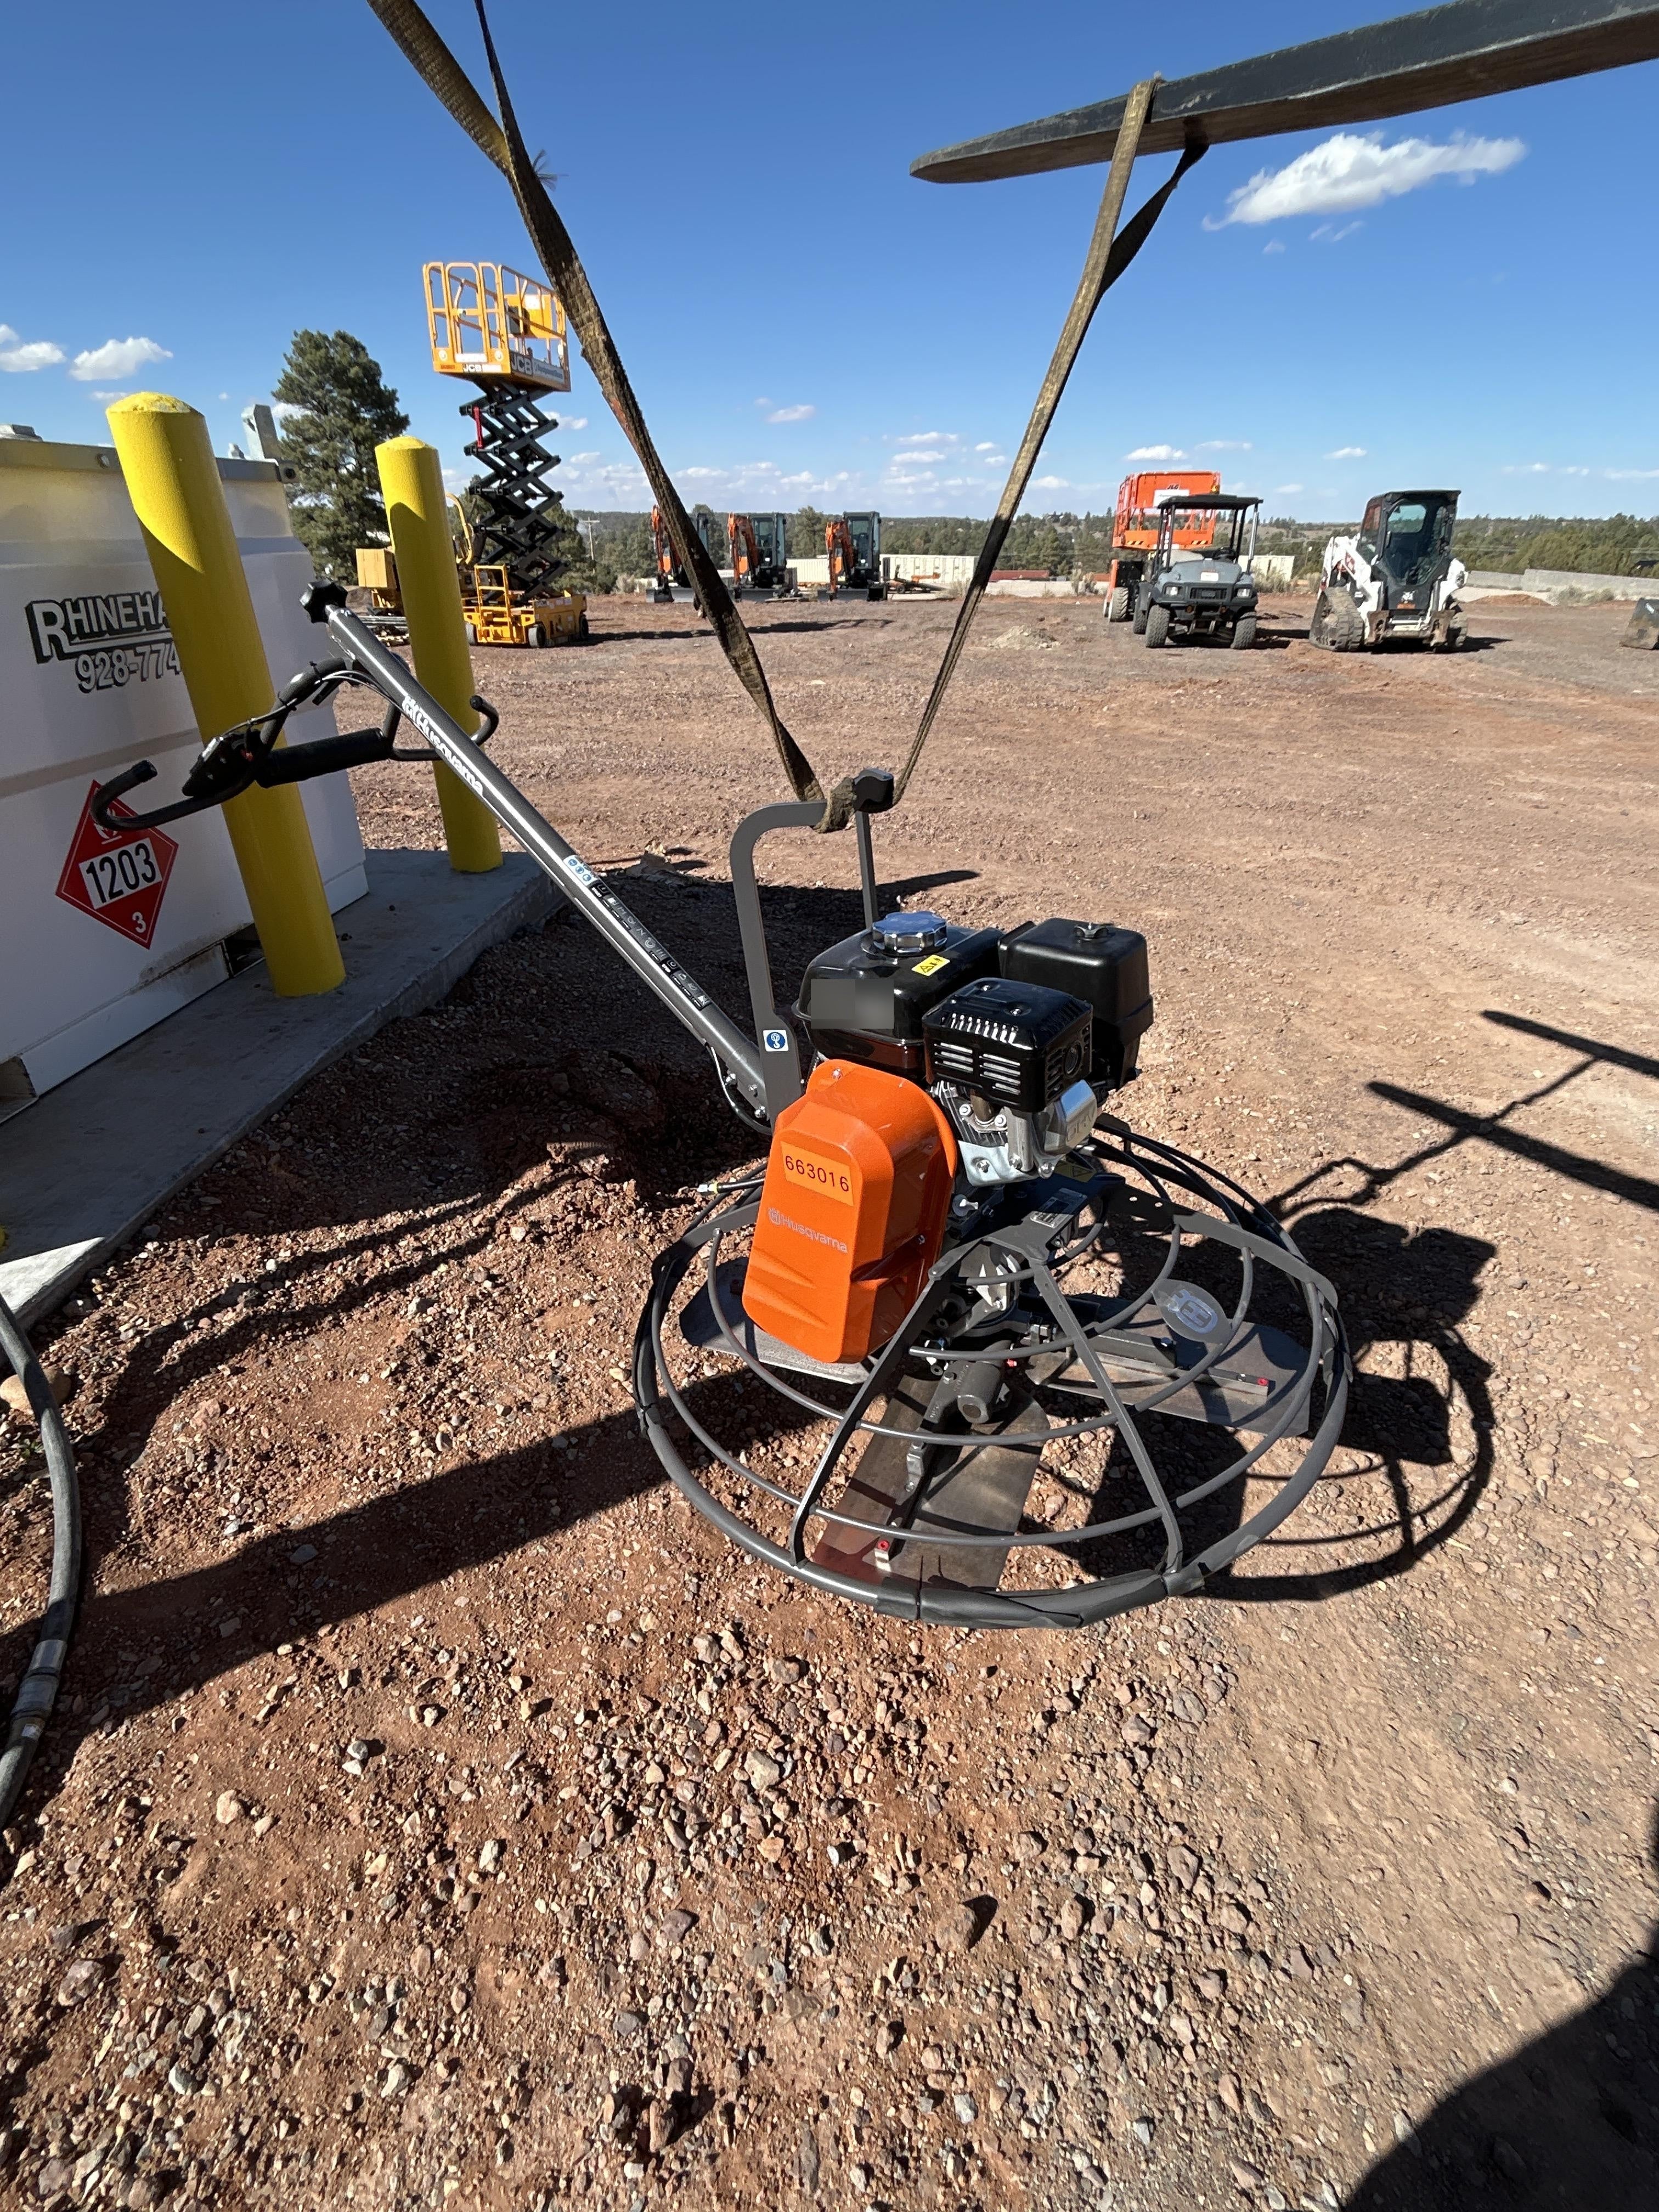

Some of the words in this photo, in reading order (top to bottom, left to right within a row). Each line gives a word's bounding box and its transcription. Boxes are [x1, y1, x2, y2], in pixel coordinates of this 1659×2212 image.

[463, 364, 482, 373] JCB
[511, 353, 532, 375] JCB
[75, 643, 182, 693] 928-774
[86, 843, 156, 903] 1203
[132, 911, 146, 933] 3
[785, 1155, 850, 1192] 663016
[780, 1214, 849, 1254] Husqvarna
